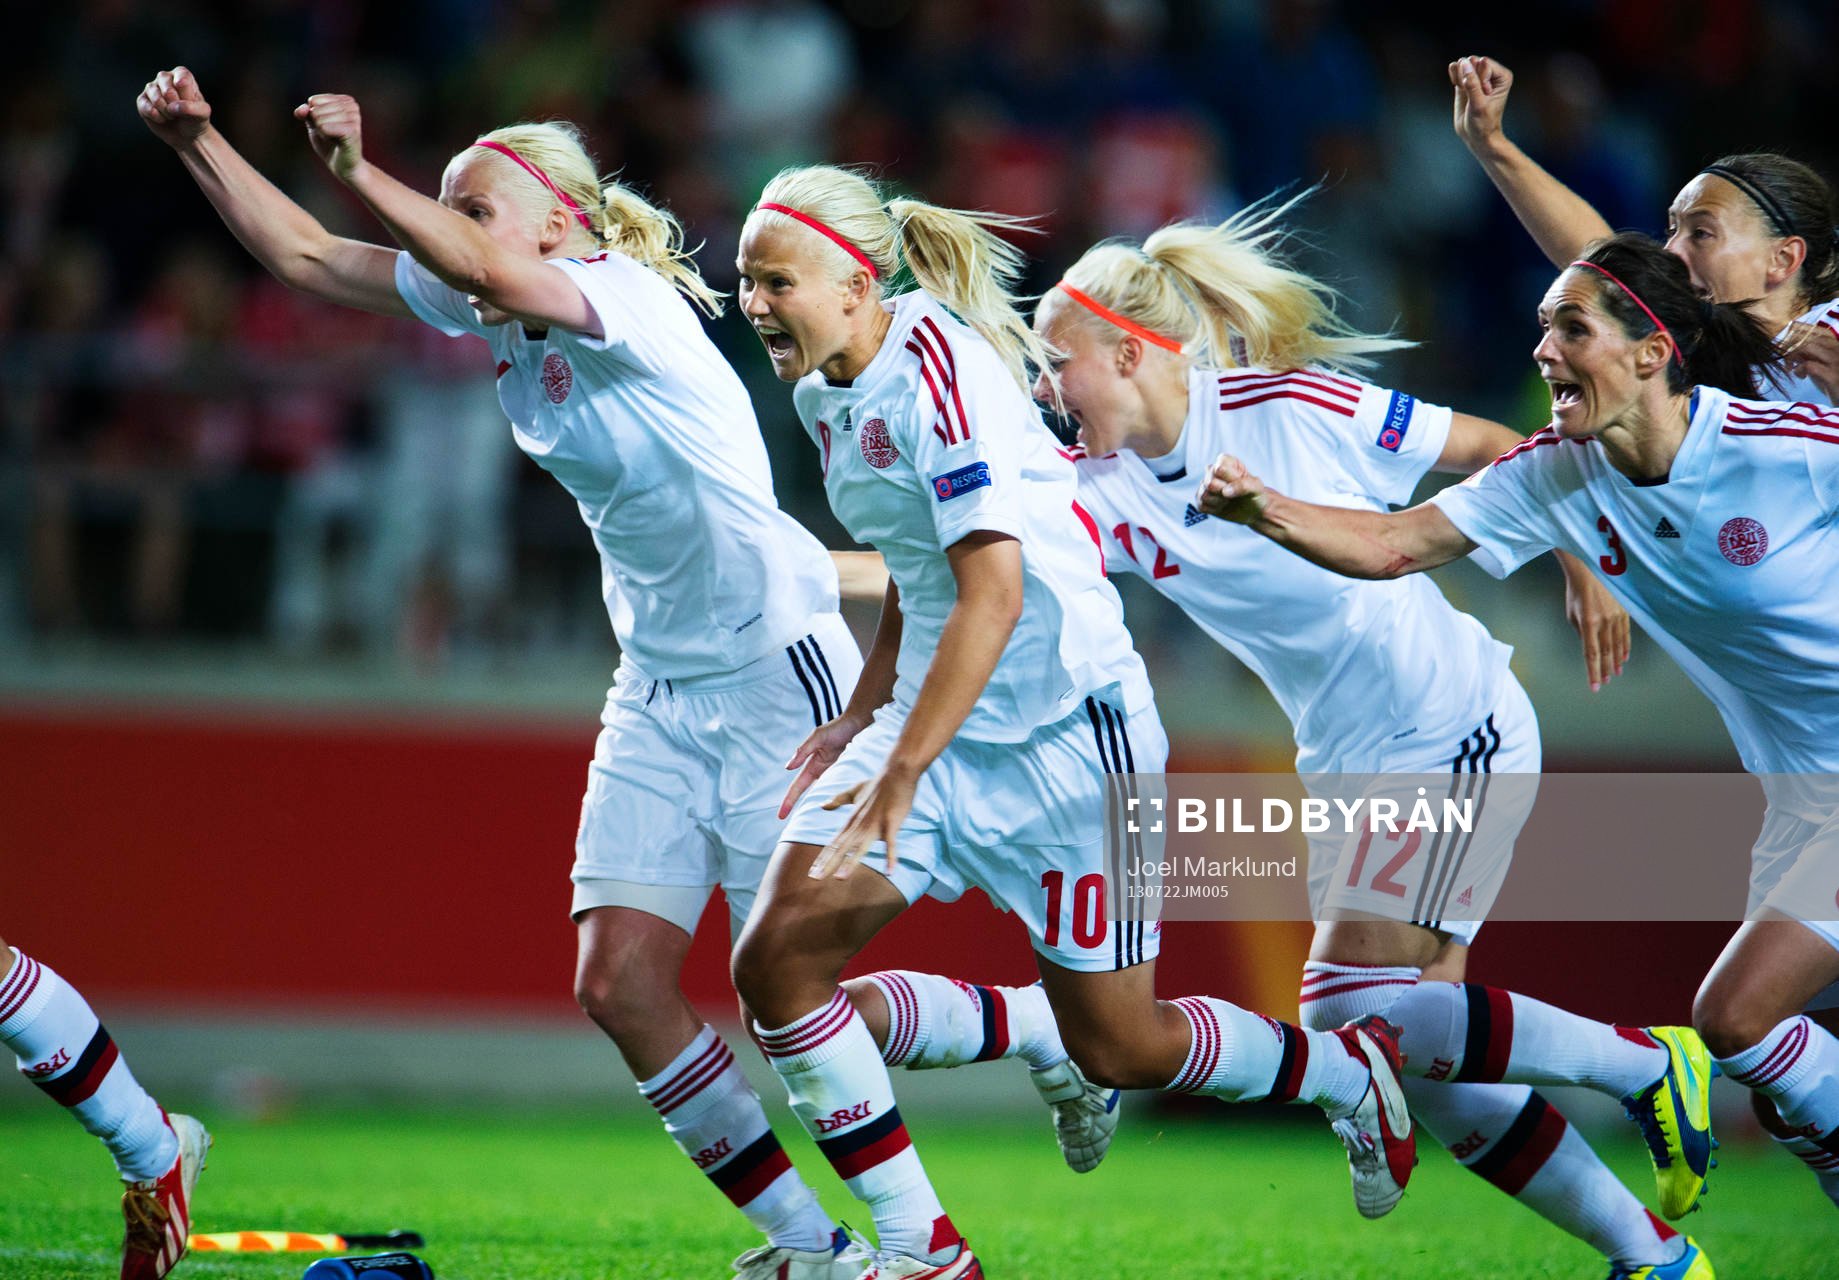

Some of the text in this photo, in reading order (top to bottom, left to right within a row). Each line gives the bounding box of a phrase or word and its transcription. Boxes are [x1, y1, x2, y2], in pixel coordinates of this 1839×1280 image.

[1112, 522, 1181, 580] 12
[1597, 515, 1627, 576] 3
[1345, 815, 1423, 899] 12
[1041, 869, 1108, 949] 10
[814, 1100, 873, 1134] DBU
